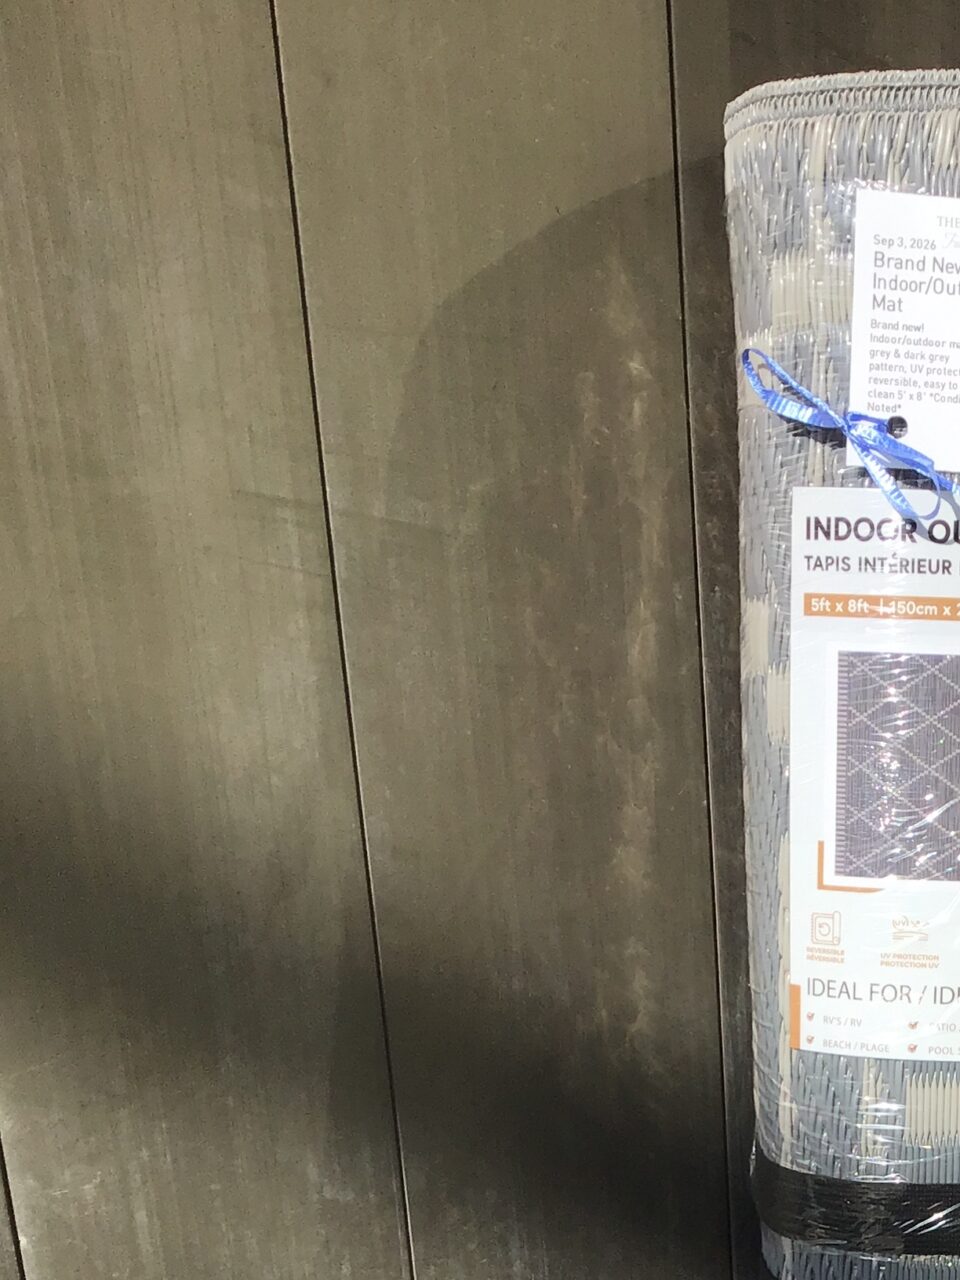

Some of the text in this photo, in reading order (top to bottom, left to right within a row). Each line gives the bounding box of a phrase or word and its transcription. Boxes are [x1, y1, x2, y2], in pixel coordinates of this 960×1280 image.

[937, 215, 960, 228] THE
[873, 234, 895, 249] Sep
[897, 236, 907, 249] 3,
[909, 237, 937, 251] 2026
[873, 250, 926, 272] Brand
[871, 293, 904, 313] Mat
[870, 318, 925, 333] Brand new!
[870, 333, 946, 348] Indoor/outdoor
[869, 348, 950, 365] grey & dark grey
[869, 362, 907, 374] pattern,
[910, 363, 925, 374] UV
[868, 375, 958, 392] reversible, easy to
[867, 388, 895, 400] clean
[806, 516, 917, 543] INDOOR
[804, 555, 851, 572] TAPIS
[858, 552, 952, 575] INTÉRIEUR
[811, 597, 831, 612] 5ft
[835, 602, 844, 612] x
[847, 598, 870, 613] 8ft
[943, 605, 951, 615] x
[892, 953, 940, 961] PROTECTION
[880, 961, 927, 969] PROTECTION
[807, 976, 863, 1001] IDEAL
[869, 982, 912, 1004] FOR
[822, 1015, 842, 1026] RV'S
[850, 1018, 863, 1028] RV
[929, 1022, 957, 1033] ATIO
[822, 1039, 852, 1049] BEACH
[860, 1042, 890, 1053] PLAGE
[928, 1046, 954, 1056] POOL
